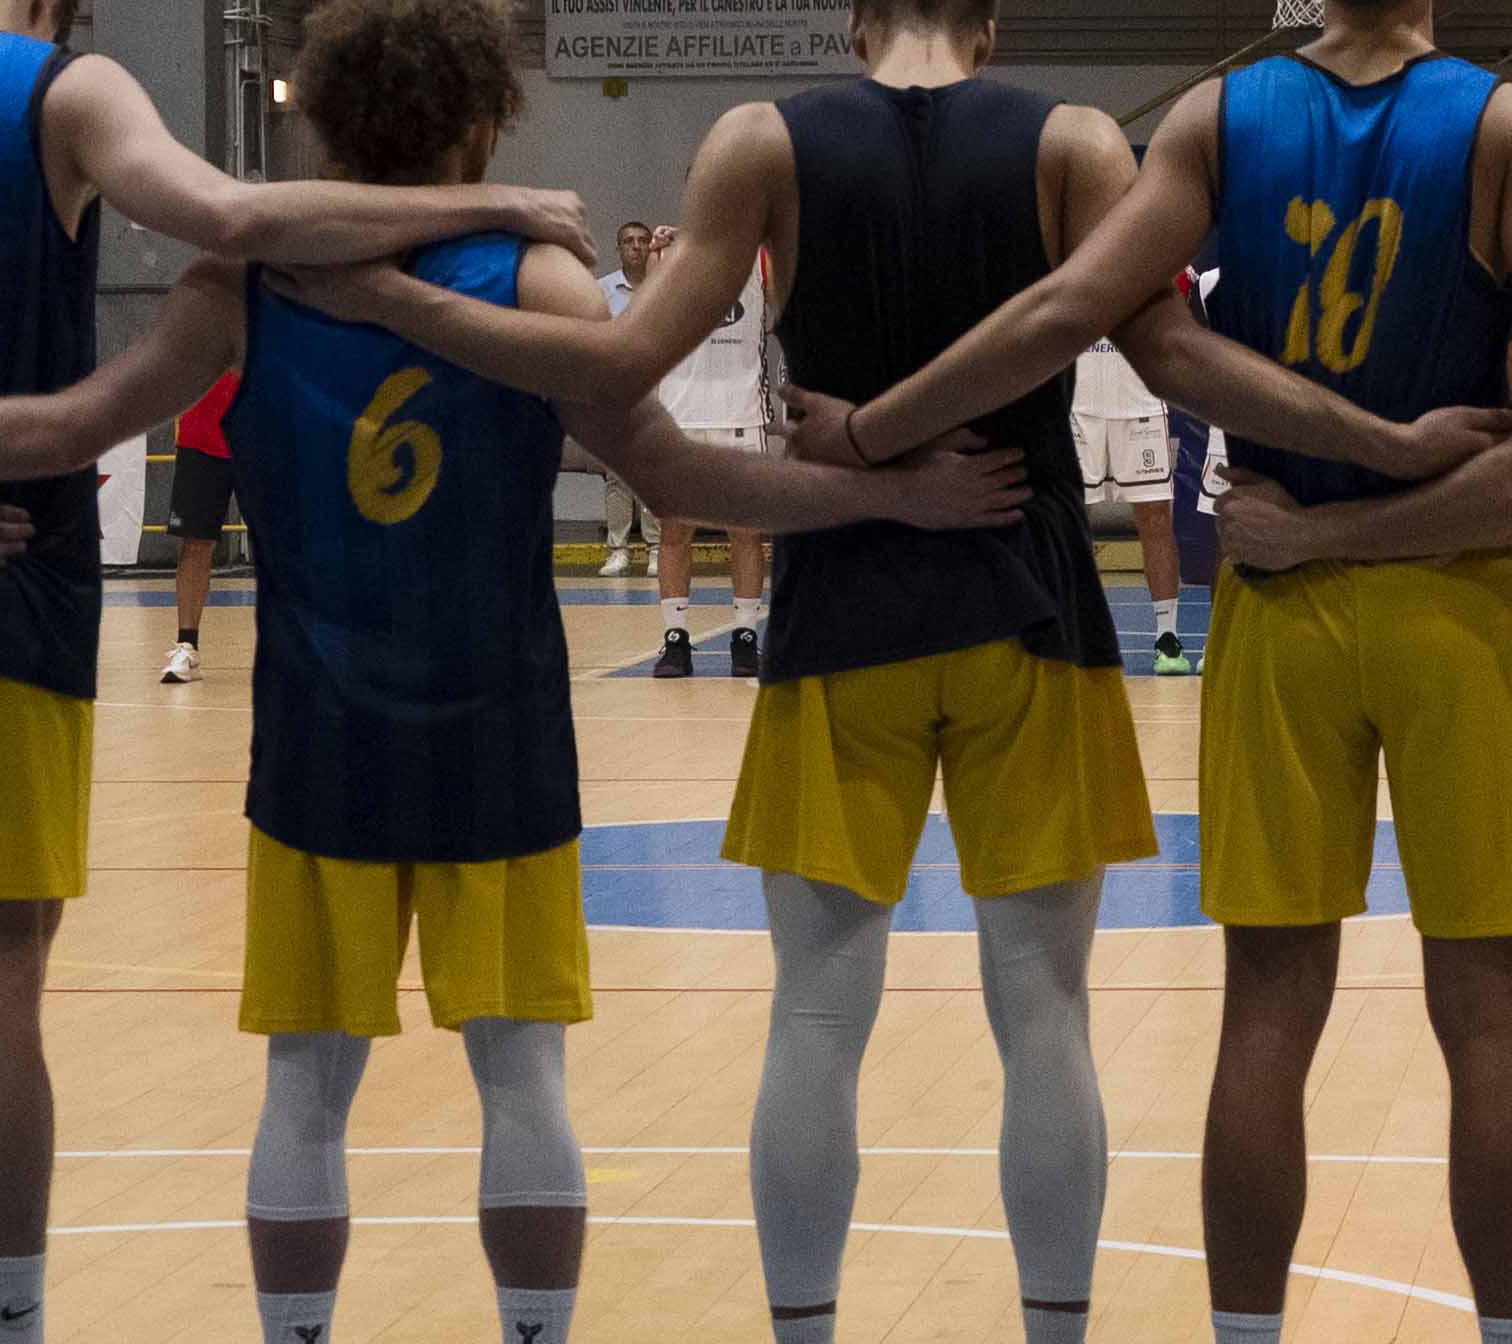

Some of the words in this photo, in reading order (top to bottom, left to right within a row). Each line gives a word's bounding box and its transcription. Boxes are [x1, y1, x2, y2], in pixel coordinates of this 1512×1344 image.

[556, 35, 660, 58] AGENZIE
[666, 34, 786, 58] AFFILIATE
[790, 40, 802, 56] a
[809, 32, 855, 55] PAV
[345, 365, 444, 526] 6
